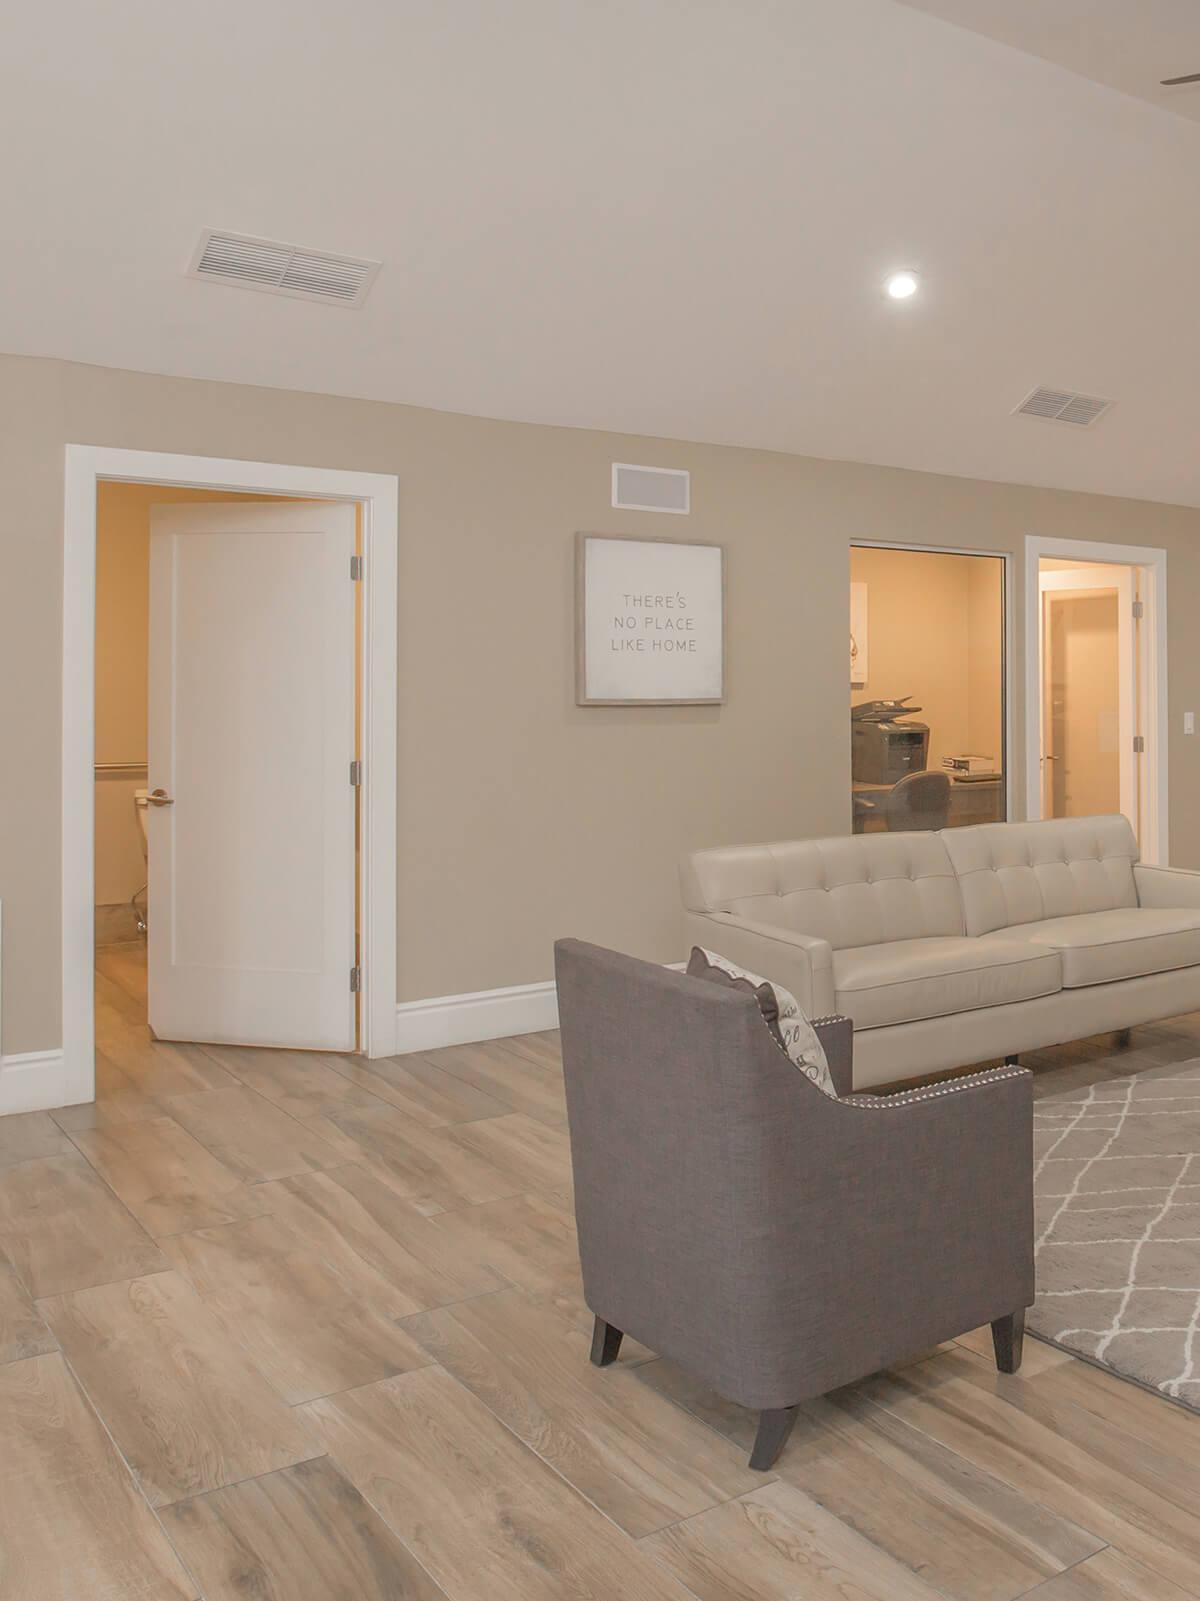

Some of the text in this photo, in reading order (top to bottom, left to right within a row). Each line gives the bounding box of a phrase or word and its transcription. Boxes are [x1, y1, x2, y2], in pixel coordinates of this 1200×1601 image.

[623, 592, 687, 609] THERE'S
[614, 616, 696, 630] NO PLACE
[610, 639, 697, 652] LIKE HOME
